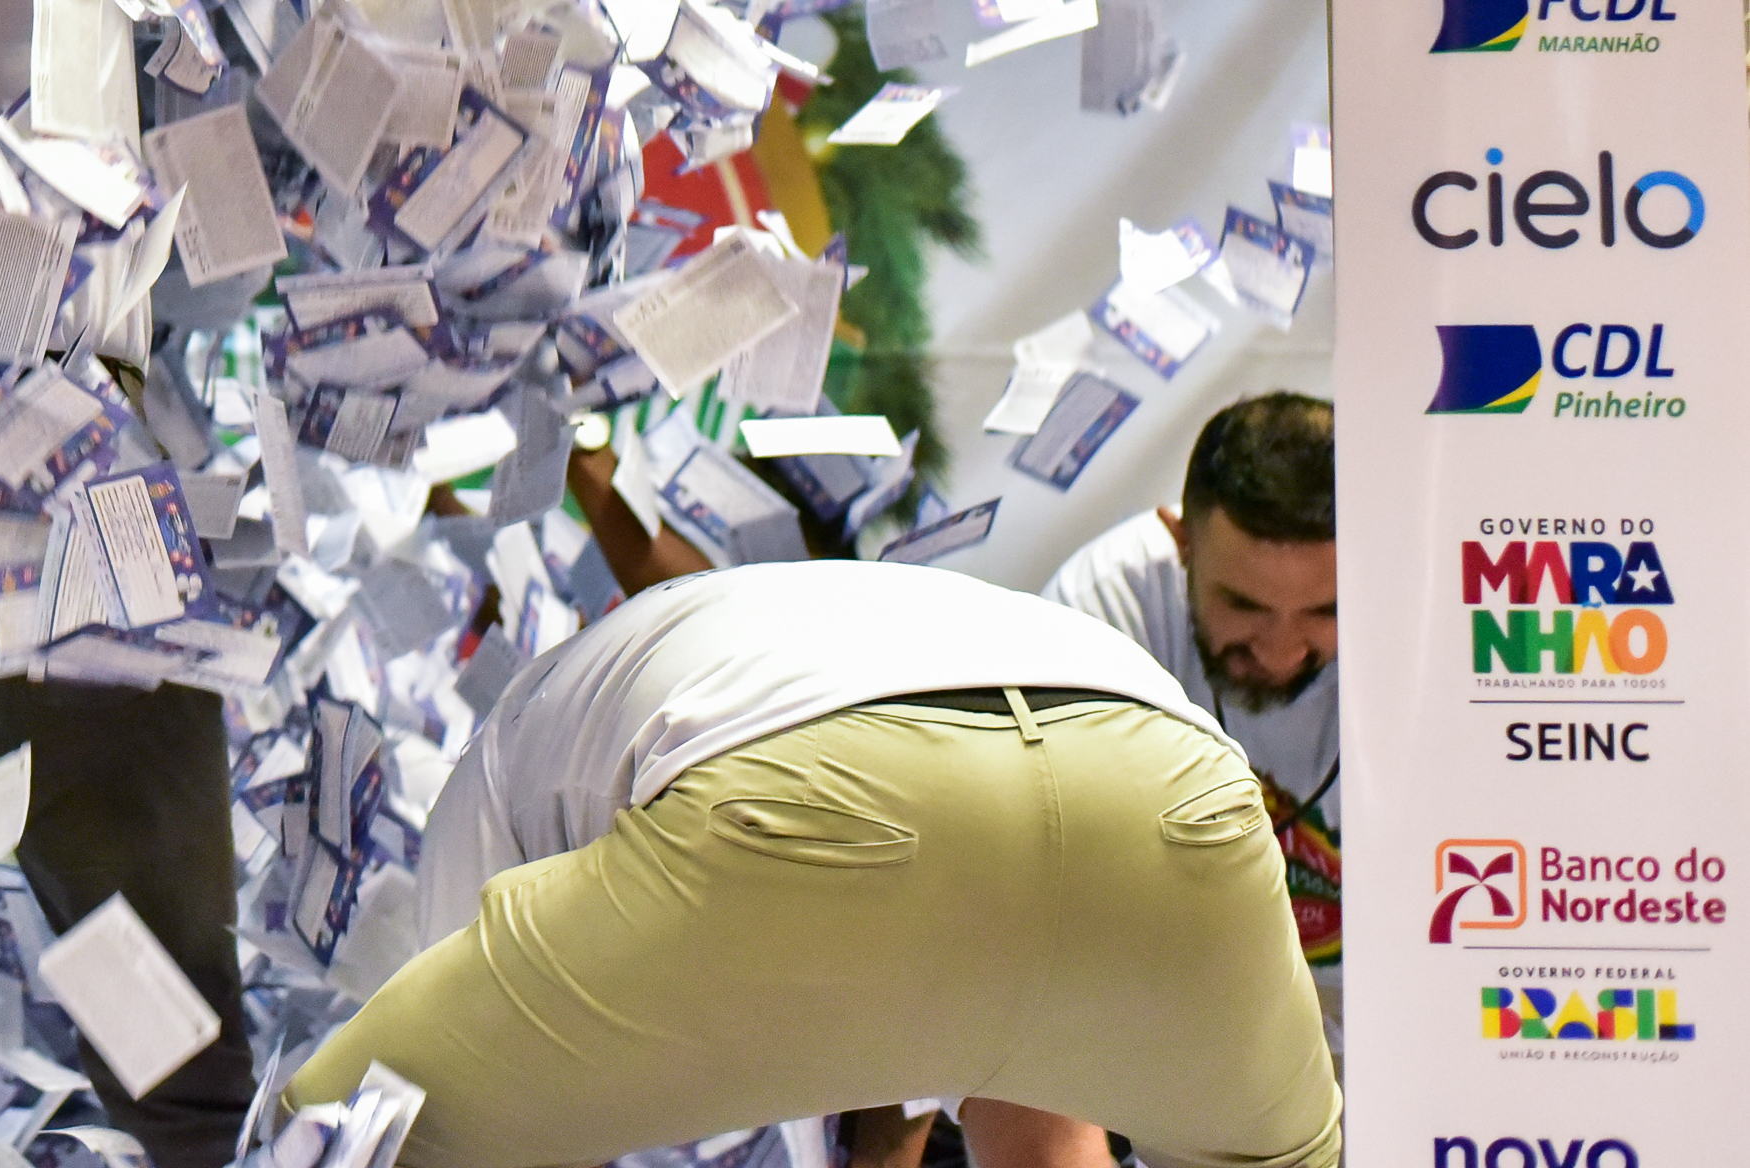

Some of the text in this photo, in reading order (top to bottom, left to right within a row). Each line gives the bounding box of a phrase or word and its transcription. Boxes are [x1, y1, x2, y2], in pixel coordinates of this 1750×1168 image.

[1538, 33, 1661, 53] MARANHÃO
[1412, 147, 1706, 250] cielo
[1551, 322, 1675, 379] CDL
[1554, 390, 1687, 418] Pinheiro
[1480, 518, 1655, 535] GOVERNO DO
[1461, 540, 1675, 605] MARA
[1476, 678, 1666, 689] TRABALHANDO PARA TODOS
[1505, 722, 1650, 762] SEINC
[1541, 846, 1726, 883] Banco do
[1541, 888, 1727, 924] Nordeste
[1498, 966, 1676, 980] GOVERNO FEDERAL
[1481, 986, 1696, 1041] BRASIL
[1499, 1048, 1680, 1063] UNIÃO E RECONSTRUÇÃO
[1433, 1135, 1640, 1168] novo
